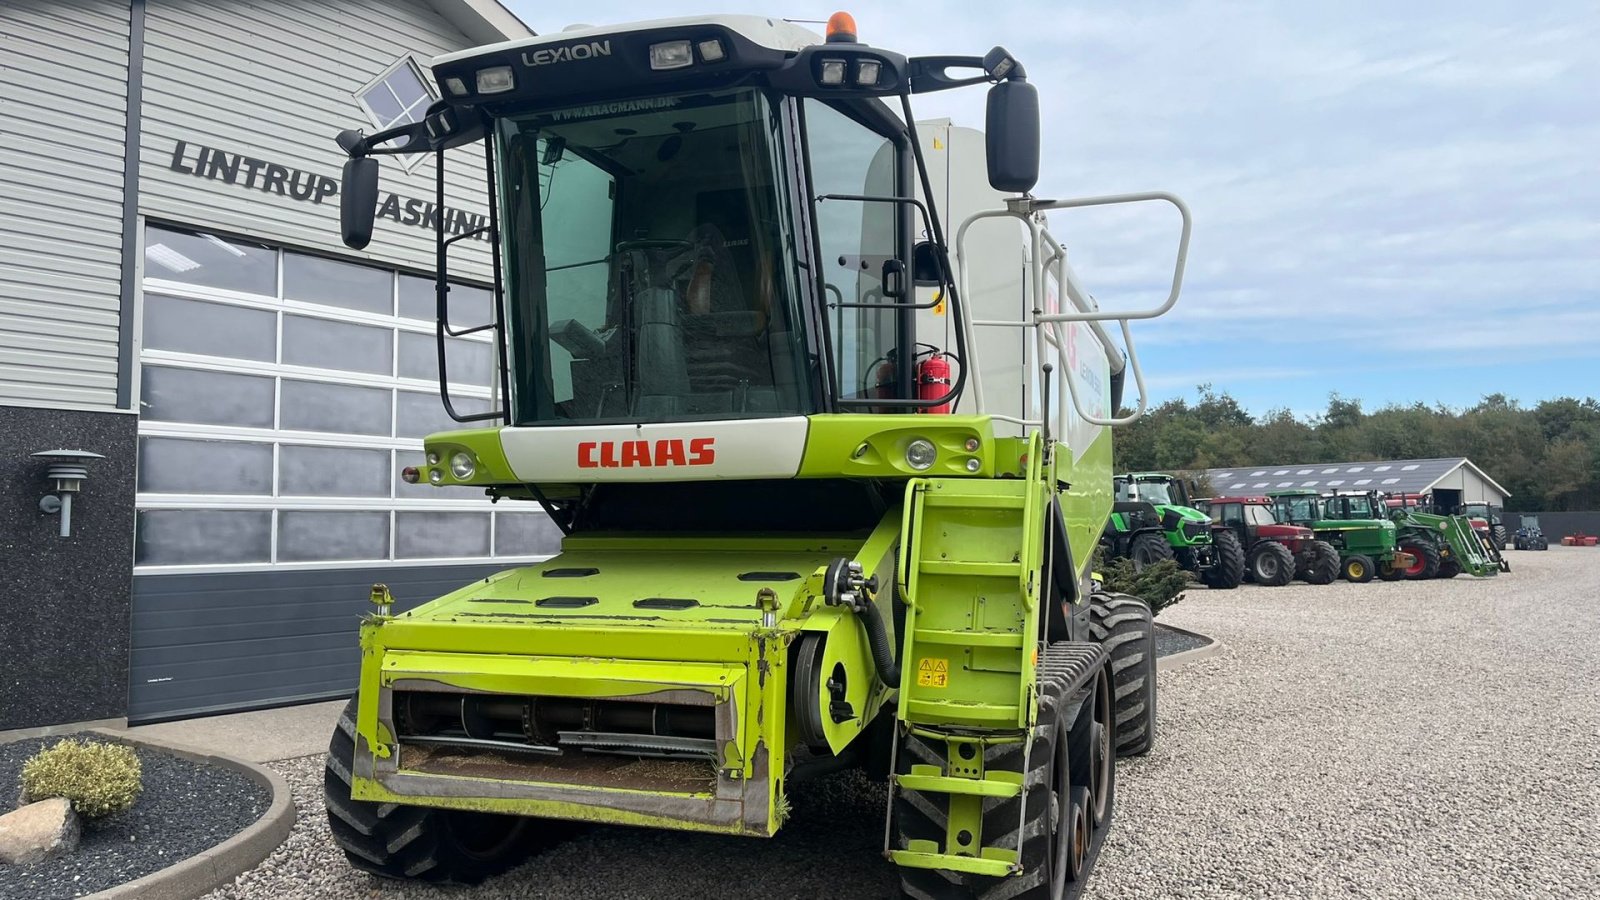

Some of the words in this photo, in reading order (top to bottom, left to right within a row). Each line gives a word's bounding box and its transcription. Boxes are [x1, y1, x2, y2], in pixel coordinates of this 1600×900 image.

[521, 40, 611, 66] LEXION
[551, 96, 676, 120] WWW.KRAGMANN.DK
[170, 140, 338, 204] LINTRUP
[376, 193, 492, 243] ASKINH
[577, 437, 716, 468] CLAAS
